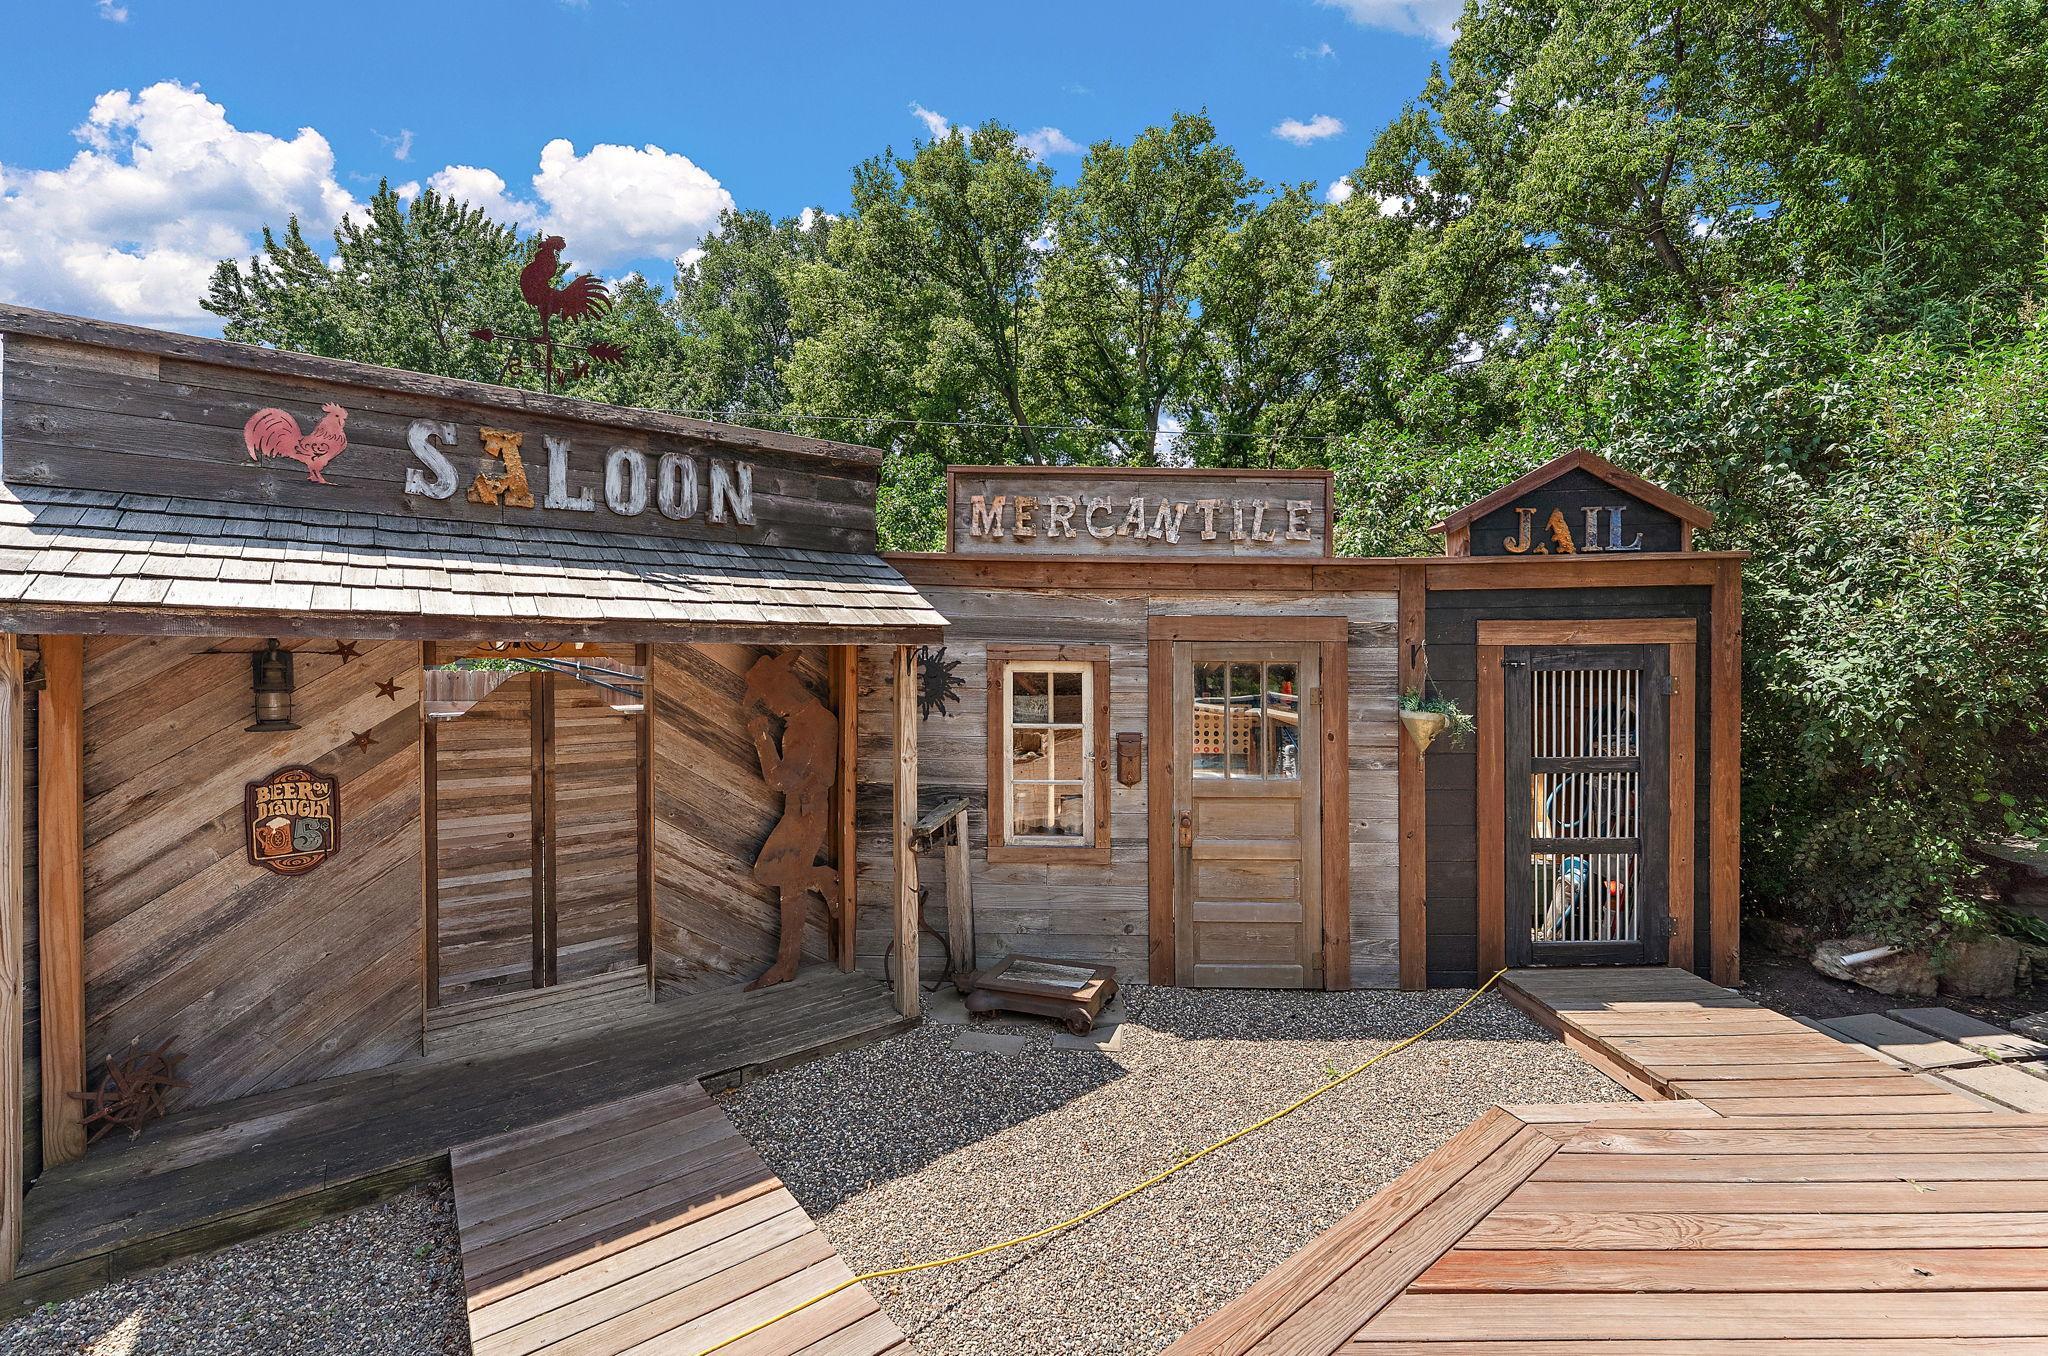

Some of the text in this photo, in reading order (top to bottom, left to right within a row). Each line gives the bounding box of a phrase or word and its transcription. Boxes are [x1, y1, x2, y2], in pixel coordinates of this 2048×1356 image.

[405, 419, 757, 526] SALOON
[969, 495, 1313, 545] MERCANTILE
[1503, 505, 1644, 555] JAIL
[255, 782, 316, 803] BEER
